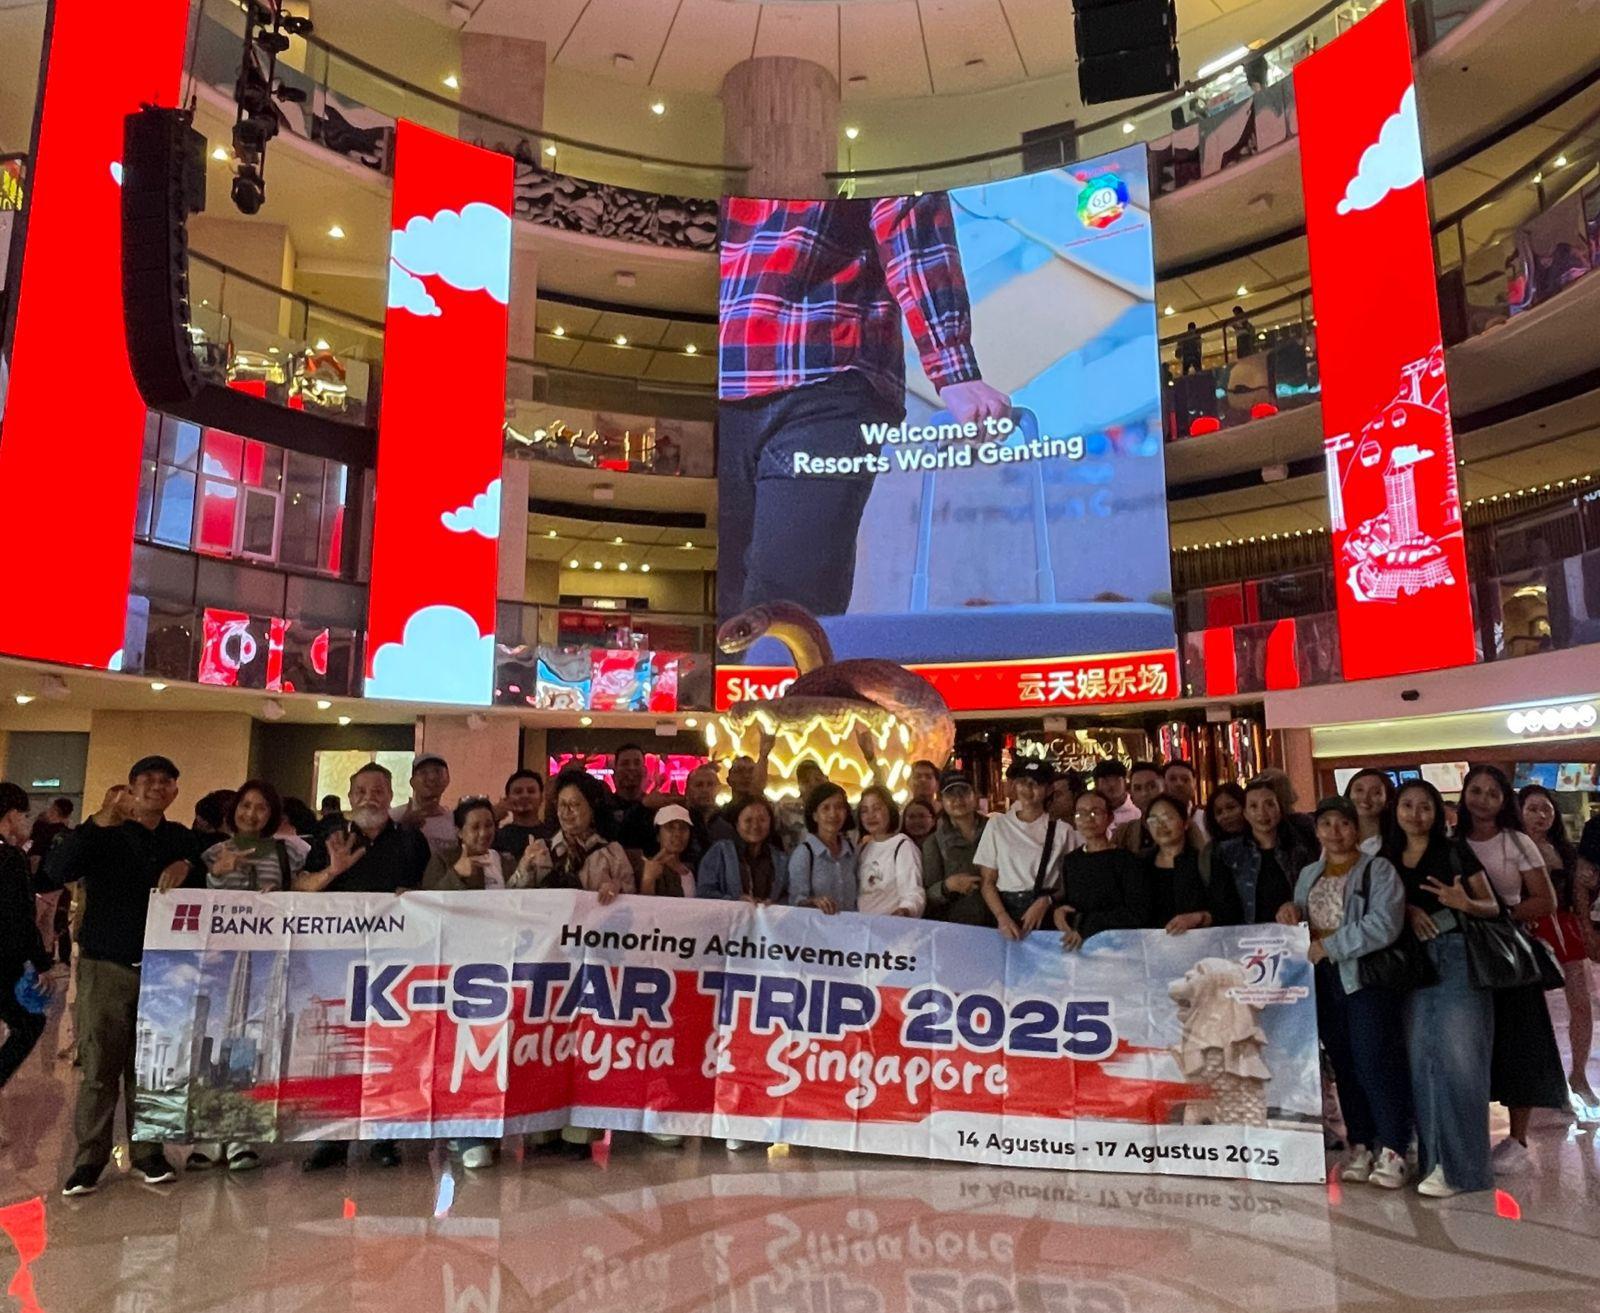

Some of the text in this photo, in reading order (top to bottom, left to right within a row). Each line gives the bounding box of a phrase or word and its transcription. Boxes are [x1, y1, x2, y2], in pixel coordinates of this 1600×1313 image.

[860, 416, 1013, 445] Welcome to
[793, 434, 1083, 474] Resorts World Genting
[1017, 663, 1168, 701] 云天娱乐场
[211, 915, 405, 935] BANK KERTIAWAN
[231, 905, 253, 914] BPR
[561, 924, 917, 972] Honoring Achievements:
[347, 961, 1116, 1057] K-STAR TRIP 2025
[450, 1020, 1009, 1110] Malaysia & Singapore
[957, 1130, 980, 1147] 14
[986, 1133, 1076, 1154] Agustus
[1096, 1141, 1118, 1157] 17
[1125, 1142, 1219, 1163] Agustus
[1226, 1145, 1280, 1167] 2025
